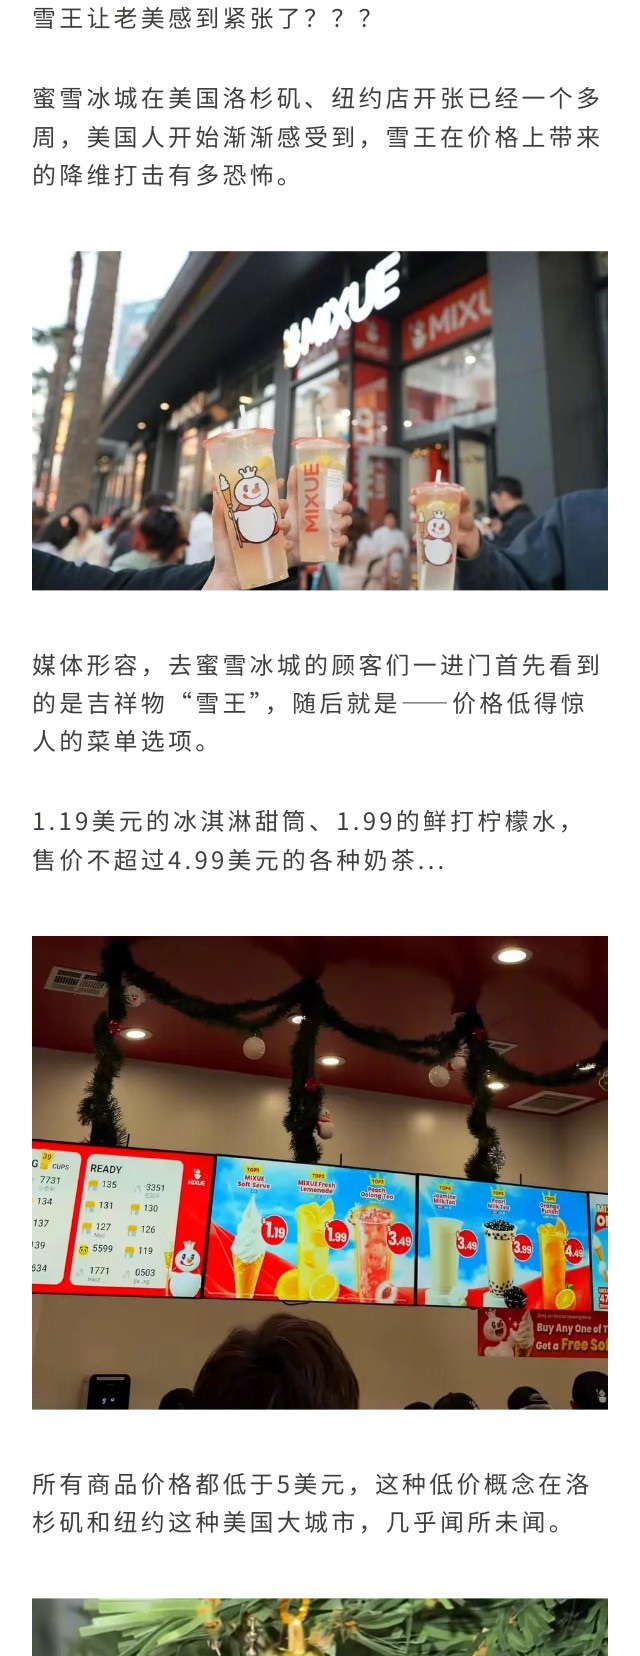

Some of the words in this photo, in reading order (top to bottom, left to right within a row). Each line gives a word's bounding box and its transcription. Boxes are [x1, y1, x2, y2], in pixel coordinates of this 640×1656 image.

[34, 87, 598, 109] 蜜雪冰城在美国洛杉矶、纽约店开张已经一个多
[33, 126, 599, 148] 周，美国人开始渐渐感受到，雪王在价格上带来
[34, 164, 285, 186] 的降维打击有多恐怖。
[301, 251, 400, 356] MIXUE
[304, 463, 319, 533] MIXUE
[33, 654, 598, 676] 媒体形容，去蜜雪冰城的顾客们一进门首先看到
[33, 730, 204, 752] 人的菜单选项。
[90, 1163, 122, 1174] READY
[102, 1180, 117, 1189] 135
[146, 1183, 165, 1192] 3351
[99, 1201, 113, 1210] 131
[144, 1204, 158, 1213] 130
[96, 1222, 111, 1231] 127
[141, 1225, 156, 1234] 126
[92, 1244, 114, 1253] 5599
[139, 1246, 153, 1255] 119
[89, 1266, 110, 1275] 1771
[135, 1268, 156, 1277] 0503
[537, 1323, 554, 1335] Buy
[556, 1324, 574, 1335] Any
[575, 1324, 592, 1333] One
[593, 1325, 601, 1333] of
[536, 1341, 552, 1350] Get
[561, 1338, 589, 1351] Free
[33, 1473, 588, 1495] 所有商品价格都低于5美元，这种低价概念在洛
[33, 1511, 557, 1533] 杉矶和纽约这种美国大城市，几乎闻所未闻。
